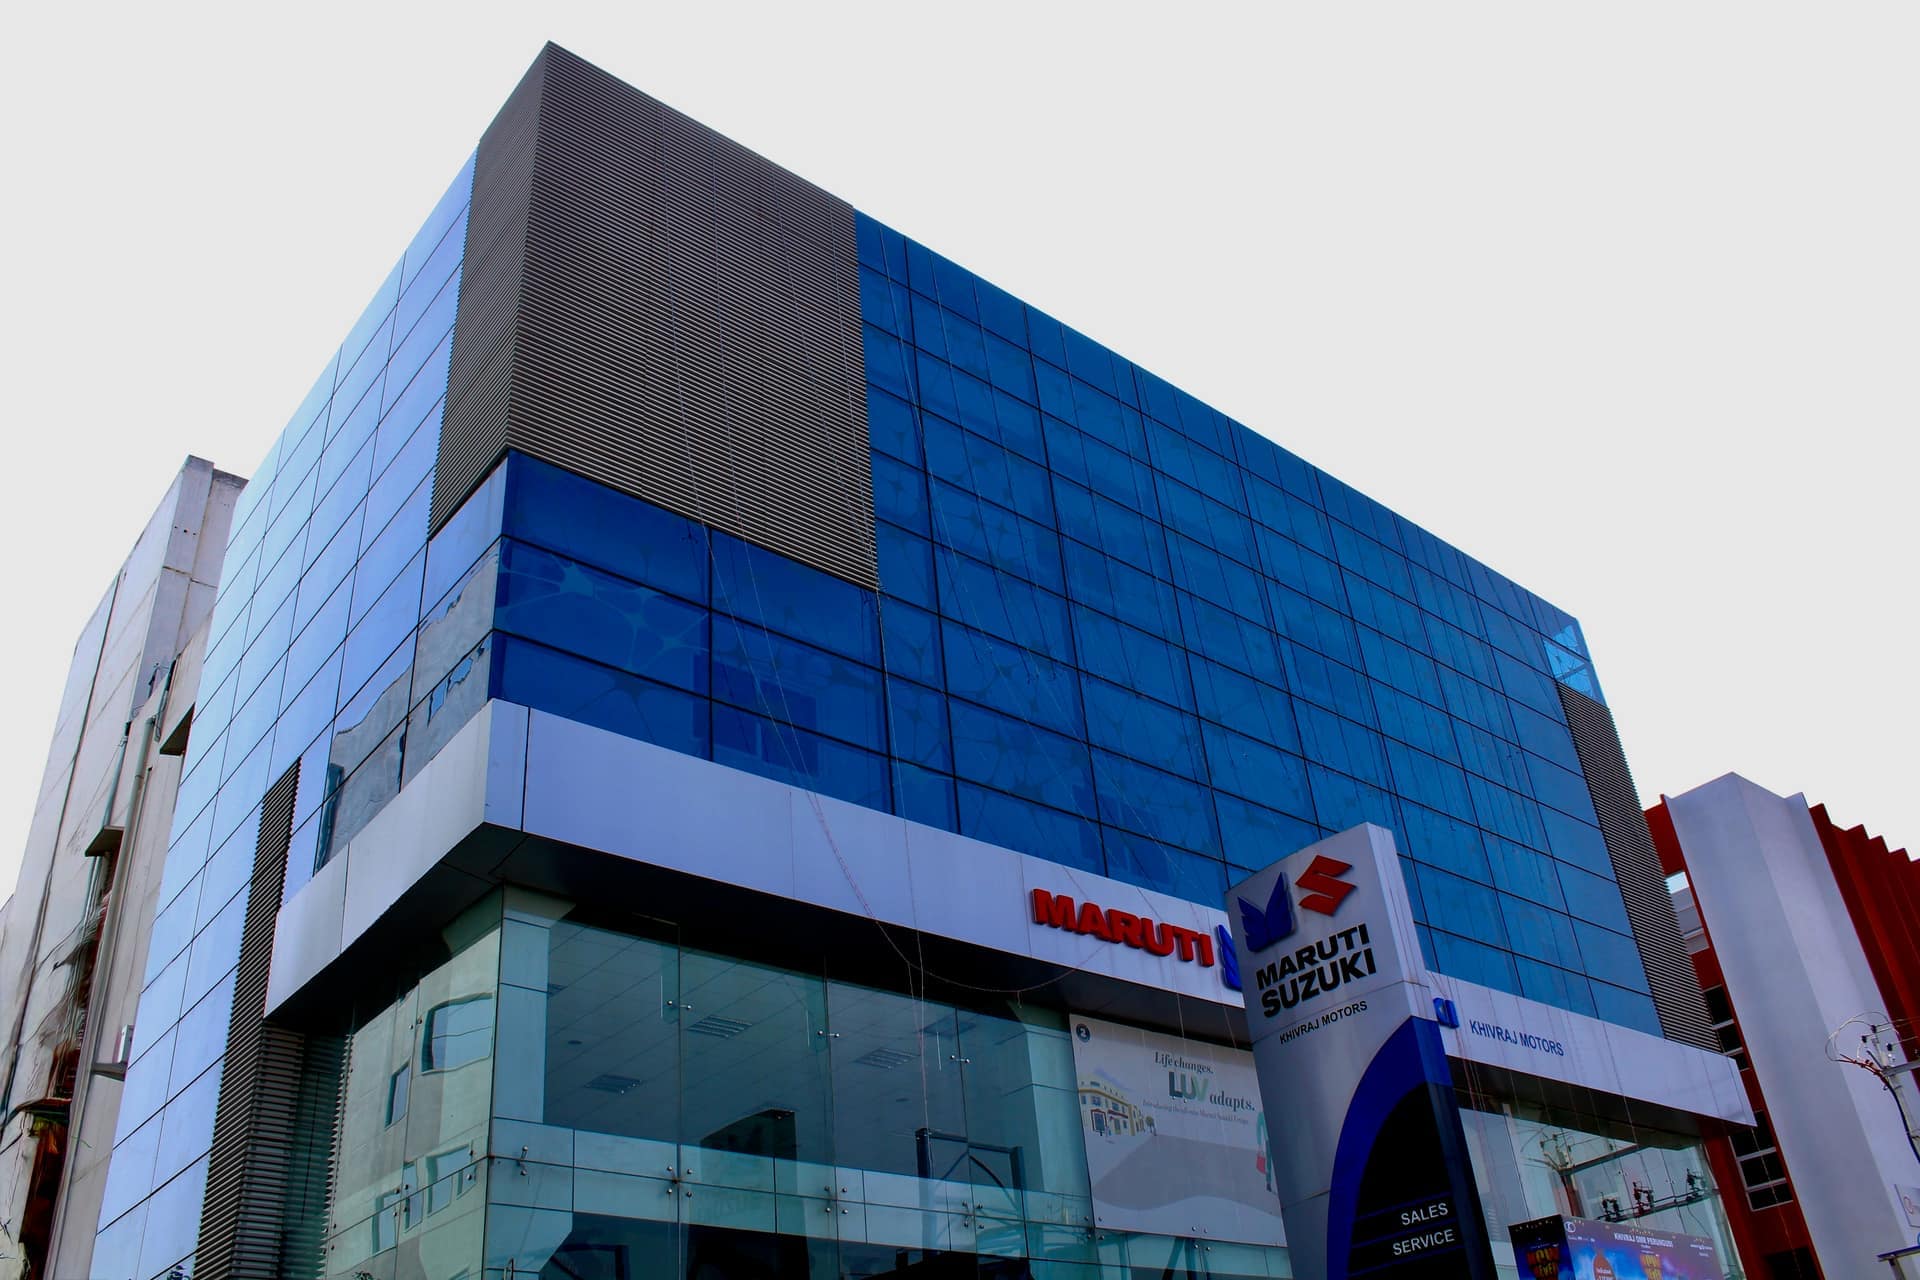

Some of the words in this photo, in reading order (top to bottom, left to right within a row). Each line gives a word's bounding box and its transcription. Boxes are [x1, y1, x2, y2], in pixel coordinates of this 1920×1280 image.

[1031, 888, 1215, 967] MARUTI
[1256, 923, 1370, 990] MARUTI
[1261, 948, 1376, 1018] SUZUKI
[1280, 1020, 1320, 1045] KHIVRAJ
[1321, 1001, 1368, 1027] MOTORS
[1469, 1019, 1518, 1045] KHIVRAJ
[1519, 1032, 1564, 1057] MOTORS
[1155, 1051, 1173, 1068] Life
[1174, 1056, 1214, 1075] changes.
[1169, 1071, 1209, 1102] LUV
[1209, 1090, 1256, 1112] adapts.
[1401, 1202, 1449, 1227] SALES
[1392, 1229, 1456, 1256] SERVICE
